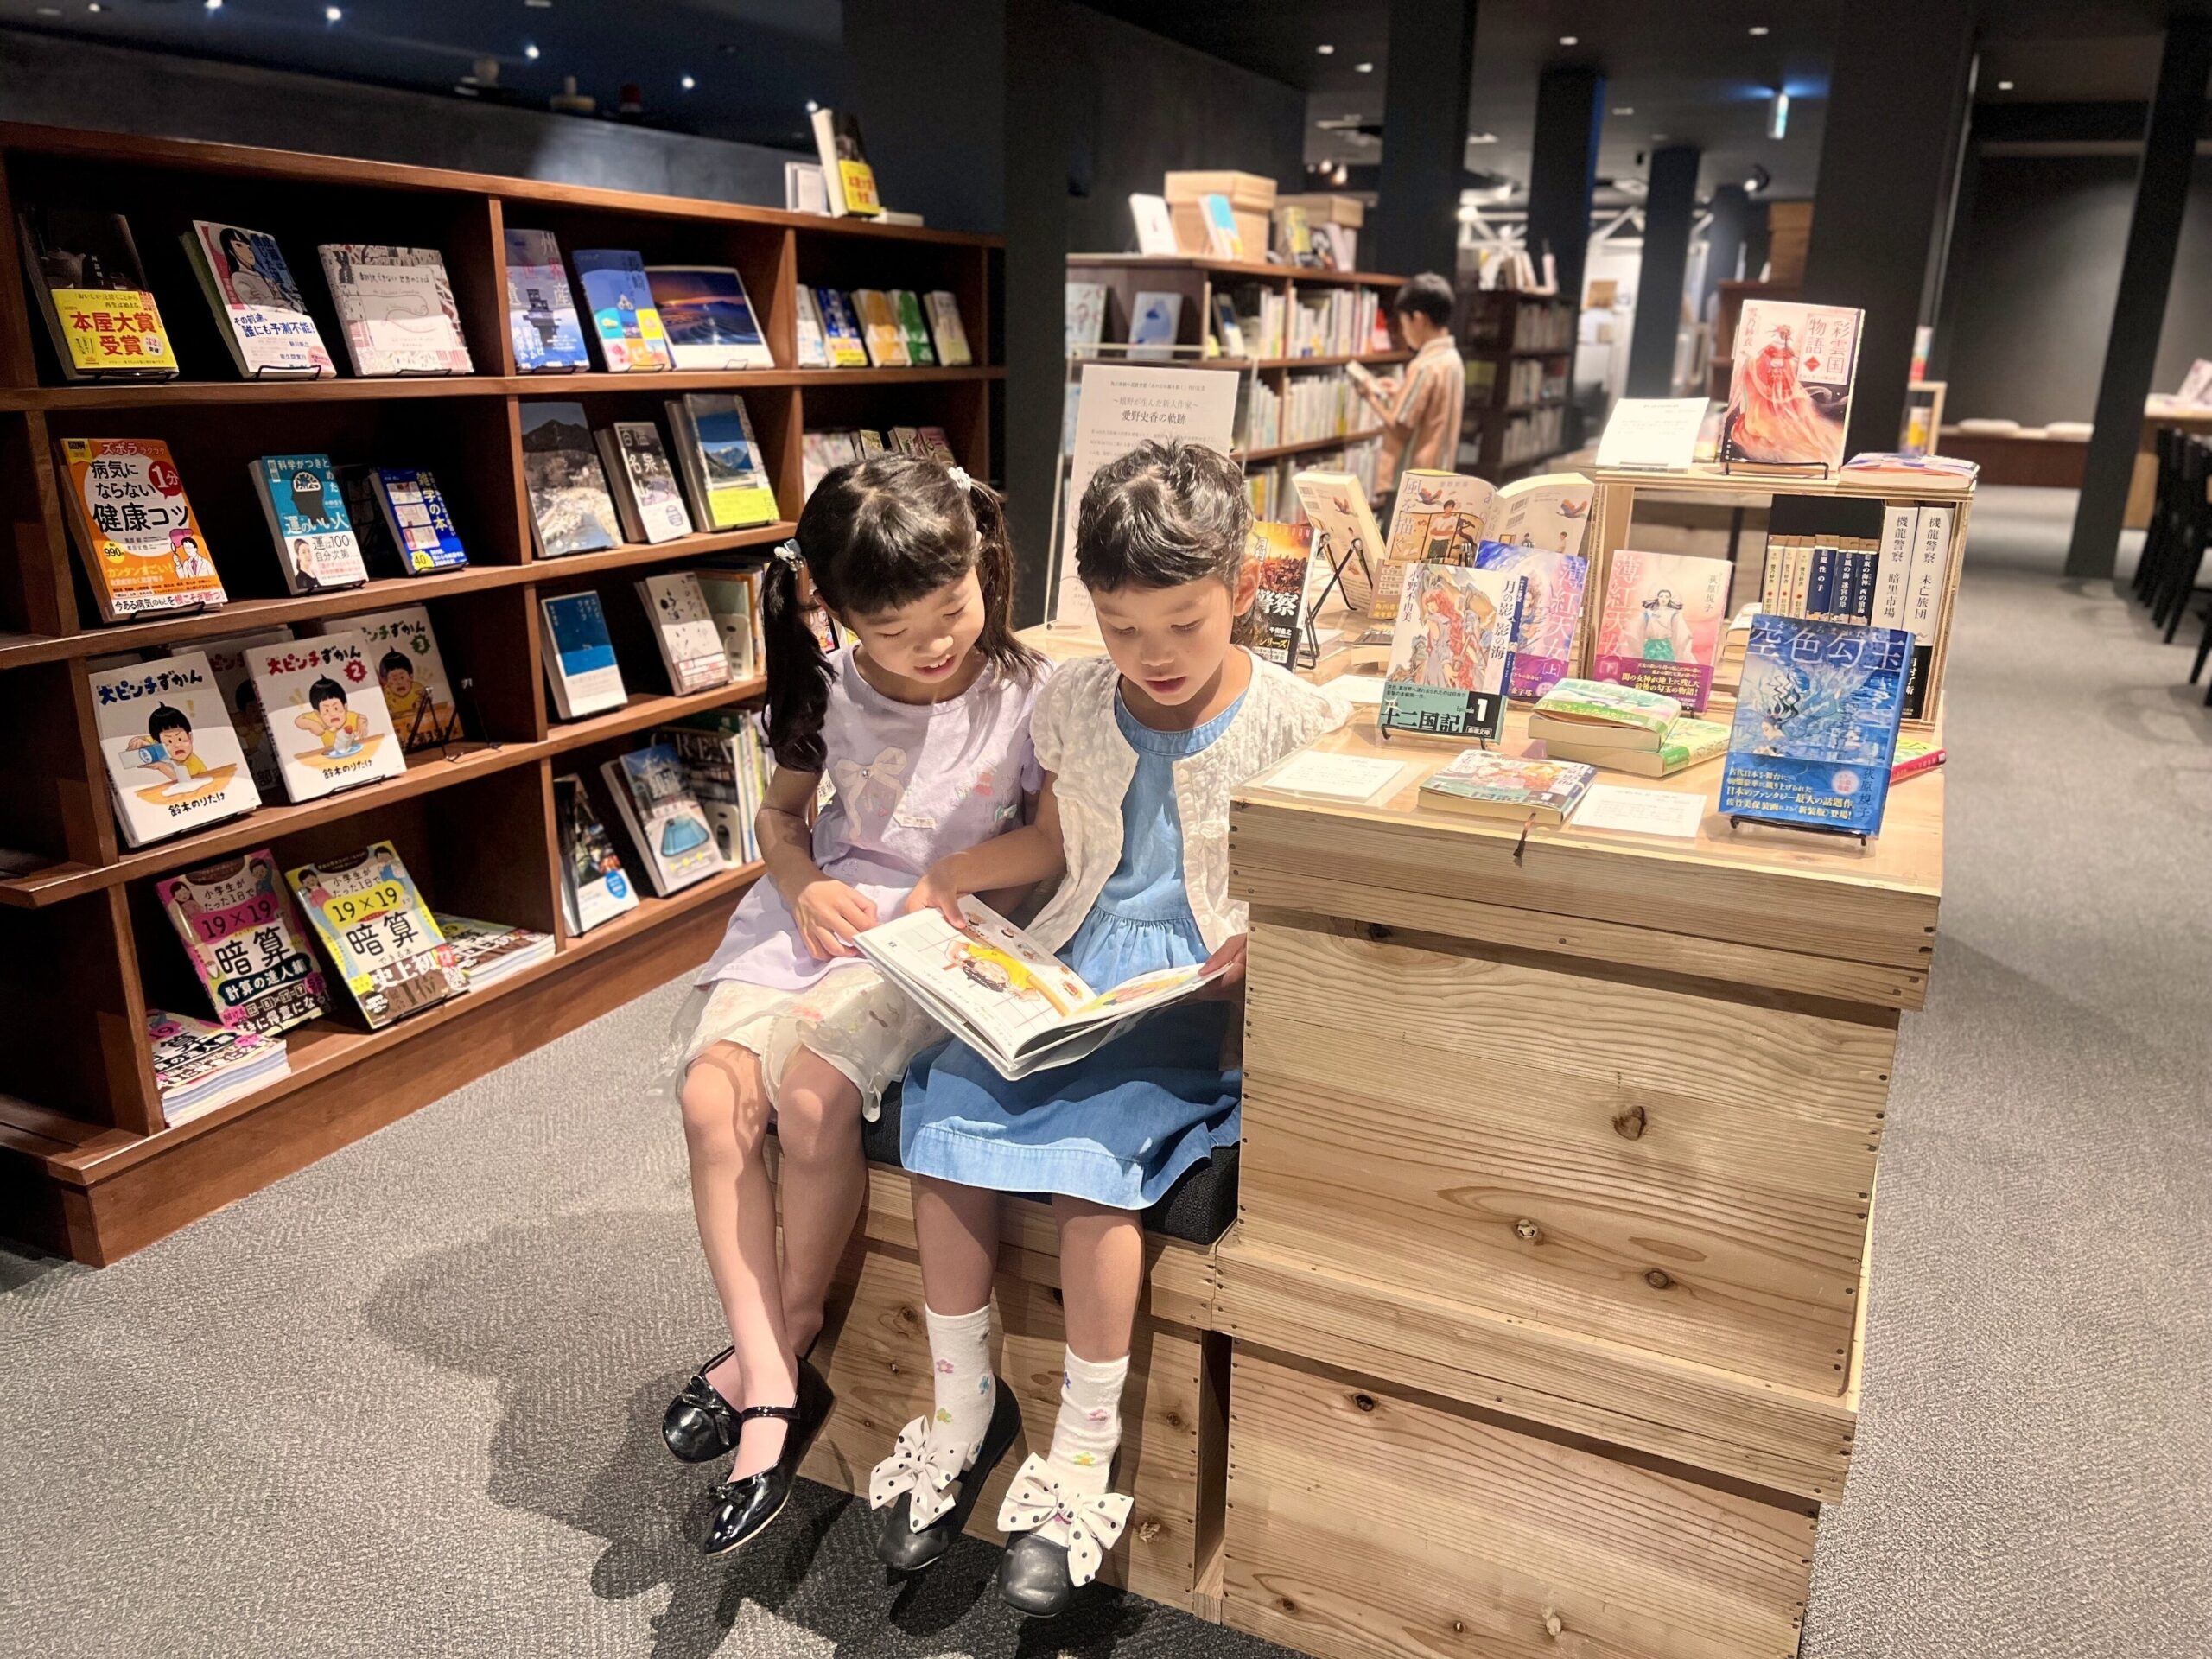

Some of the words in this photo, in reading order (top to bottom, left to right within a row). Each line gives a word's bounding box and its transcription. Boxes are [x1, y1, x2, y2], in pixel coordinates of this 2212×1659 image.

[70, 311, 156, 333] 本屋大賞
[234, 313, 267, 325] その前途、
[100, 335, 144, 355] 受賞
[1806, 317, 1827, 354] 物語
[1827, 320, 1851, 374] 彩雲国
[1122, 410, 1186, 425] 愛野史香の軌跡
[91, 460, 139, 479] 病気に
[95, 482, 156, 499] ならない
[92, 502, 188, 533] 健康コツ
[284, 512, 350, 535] 運のいい人
[1891, 516, 1908, 563] 機龍警察
[1923, 516, 1942, 563] 機龍警察
[1402, 572, 1420, 623] 小野不由美
[1498, 580, 1516, 617] 月の影
[1596, 556, 1640, 661] 薄紅天女
[1884, 573, 1901, 618] 暗黒市場
[1915, 574, 1932, 620] 未亡旅団
[416, 639, 426, 651] 3
[1491, 622, 1510, 660] 影の海
[1745, 621, 1905, 672] 空色勾玉
[267, 645, 361, 676] 大ピンチずかん
[350, 664, 362, 678] 2
[98, 669, 203, 706] 大ピンチずかん
[1381, 707, 1461, 733] 十二国記
[1476, 698, 1488, 722] 1
[322, 760, 372, 779] 鈴木のりたけ
[168, 791, 225, 817] 鈴木のりたけ
[1859, 766, 1874, 819] 荻原規子
[204, 879, 246, 899] 小学生が
[333, 868, 372, 887] 小学生が
[204, 888, 257, 912] たった1日で
[346, 911, 420, 957] 暗算
[214, 926, 290, 976] 暗算
[224, 958, 308, 1002] 計算の達人編
[372, 950, 437, 992] 史上初
